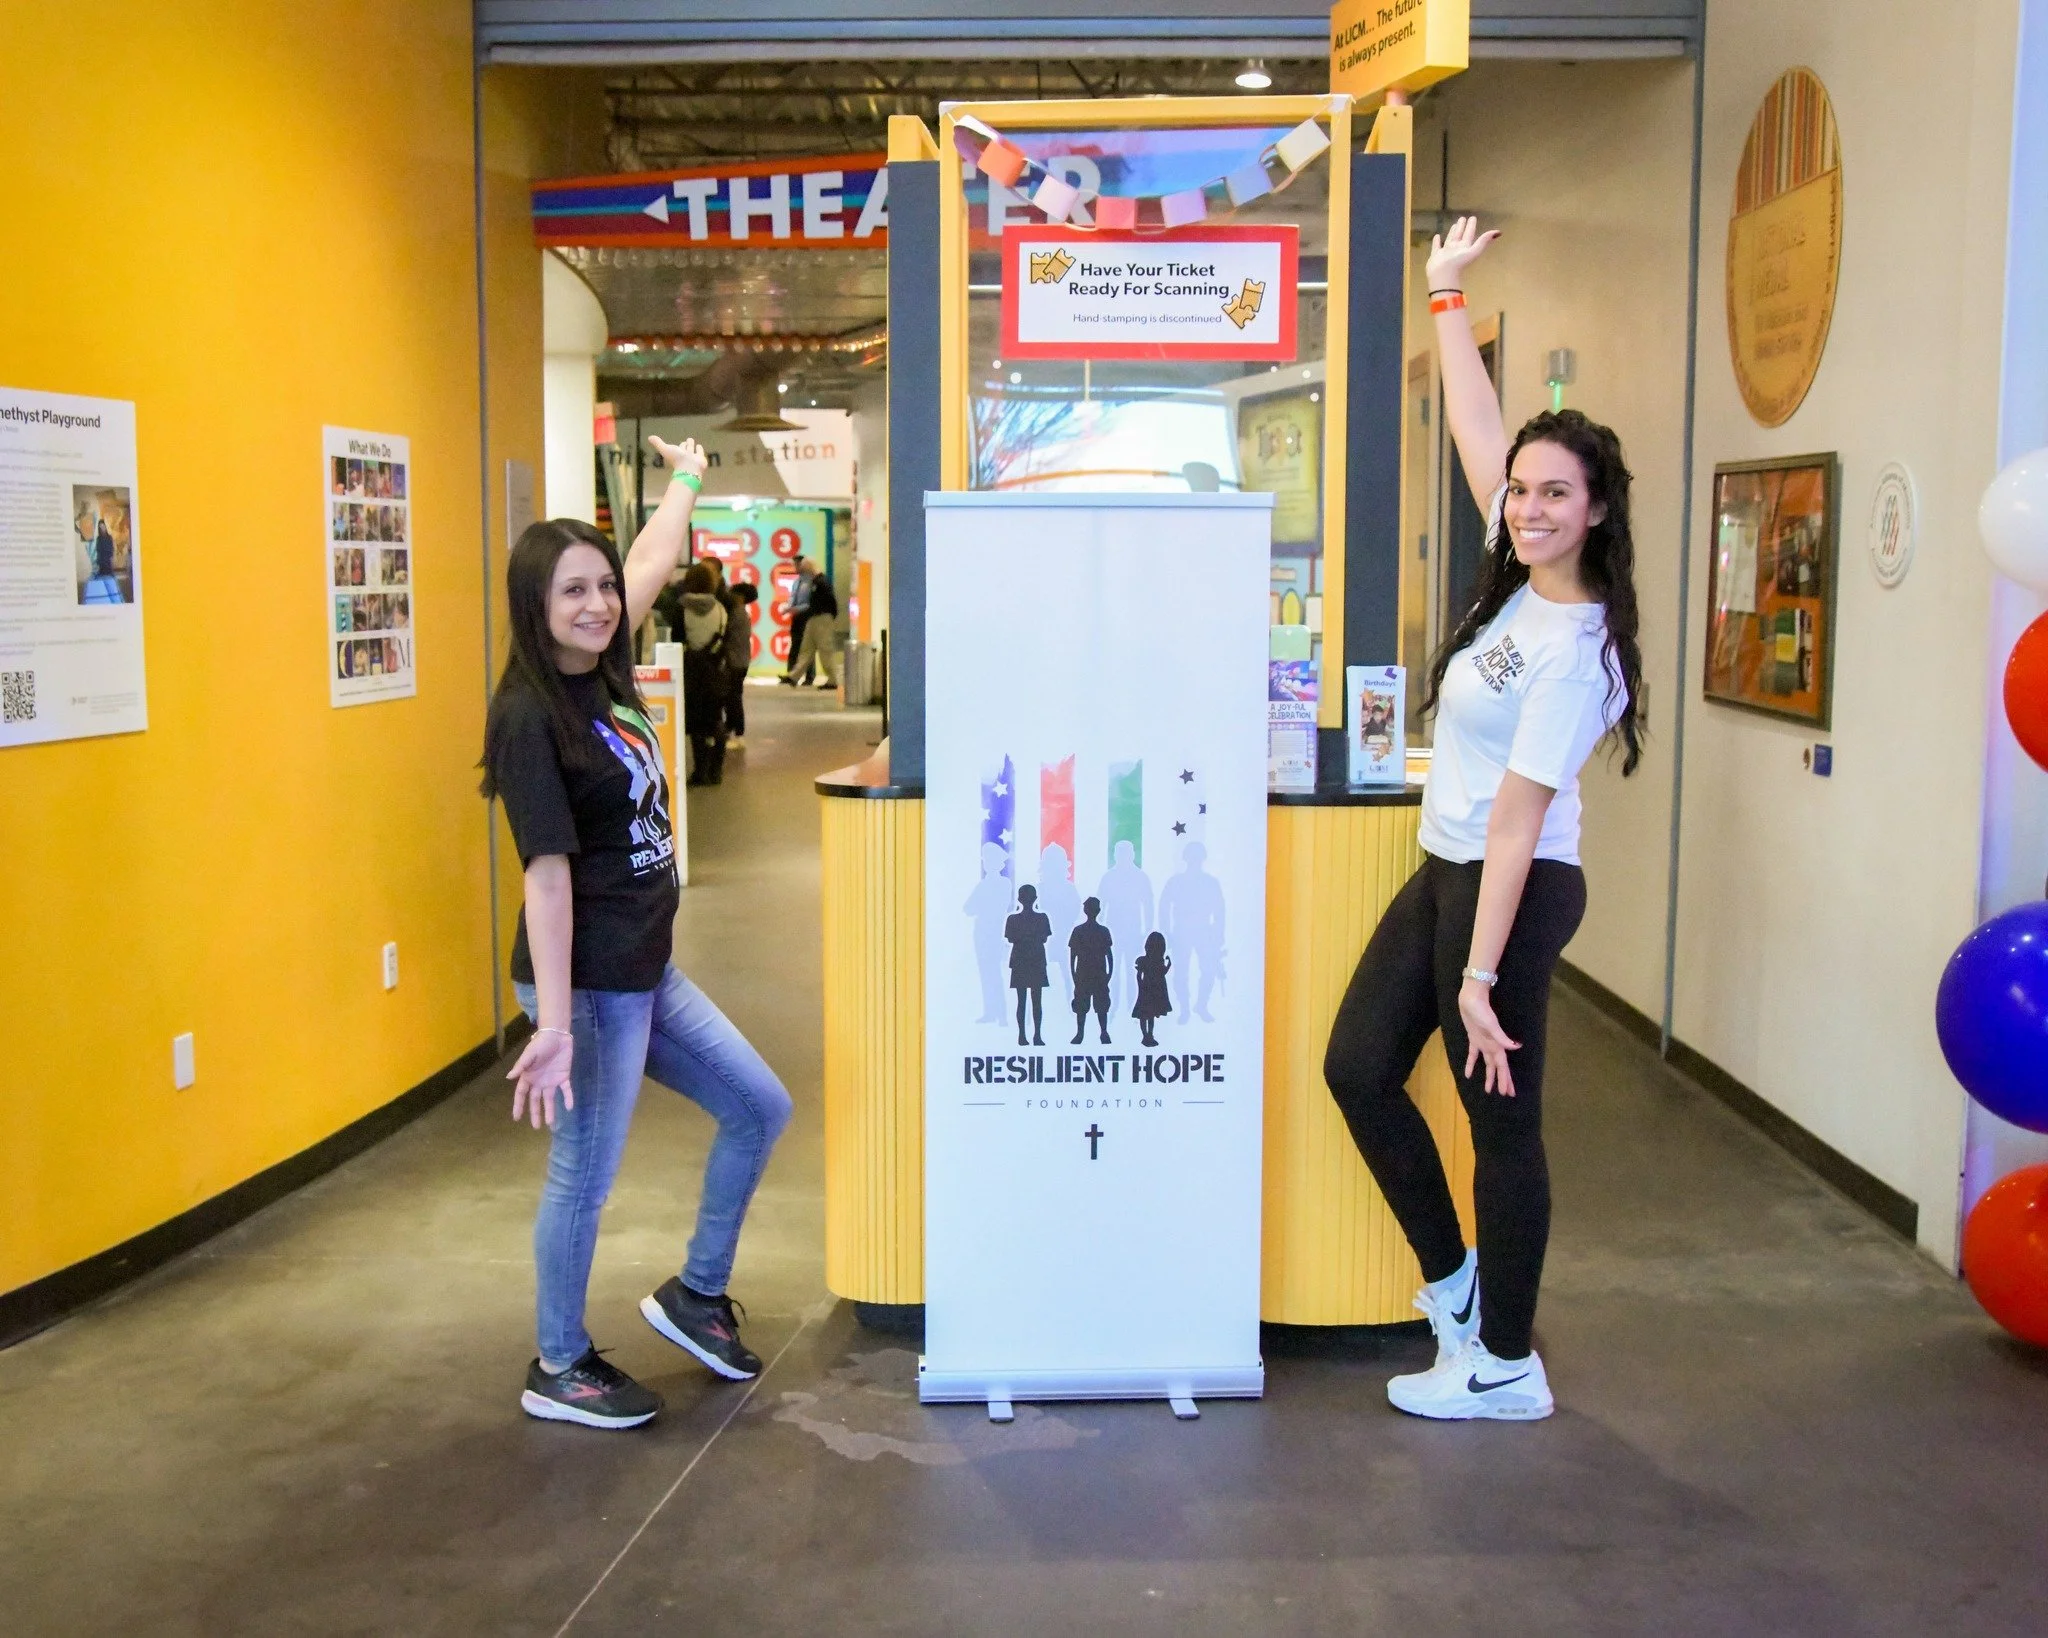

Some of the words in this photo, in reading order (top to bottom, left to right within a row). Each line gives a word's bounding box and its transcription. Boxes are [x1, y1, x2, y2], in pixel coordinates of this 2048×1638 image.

[1334, 33, 1343, 51] At
[1377, 9, 1393, 27] The
[1339, 56, 1346, 73] is
[1347, 42, 1377, 69] always
[1378, 20, 1416, 56] present.
[674, 155, 1102, 240] THEAER
[1080, 262, 1123, 277] Have
[1126, 262, 1163, 277] Your
[1166, 262, 1216, 277] Ticket
[1069, 281, 1119, 298] Ready
[1123, 281, 1151, 296] For
[1153, 281, 1230, 299] Scanning
[1150, 314, 1157, 324] is
[1159, 313, 1222, 324] discontinued
[42, 409, 101, 429] Playground
[348, 438, 368, 455] What
[369, 440, 380, 456] We
[381, 443, 392, 458] Do
[734, 438, 836, 466] station
[779, 533, 792, 553] 3
[1364, 679, 1397, 688] Birthdays
[1270, 703, 1276, 711] A
[964, 1055, 1126, 1084] RESILIENT
[1132, 1054, 1225, 1084] HOPE
[1026, 1098, 1163, 1109] FOUNDATION
